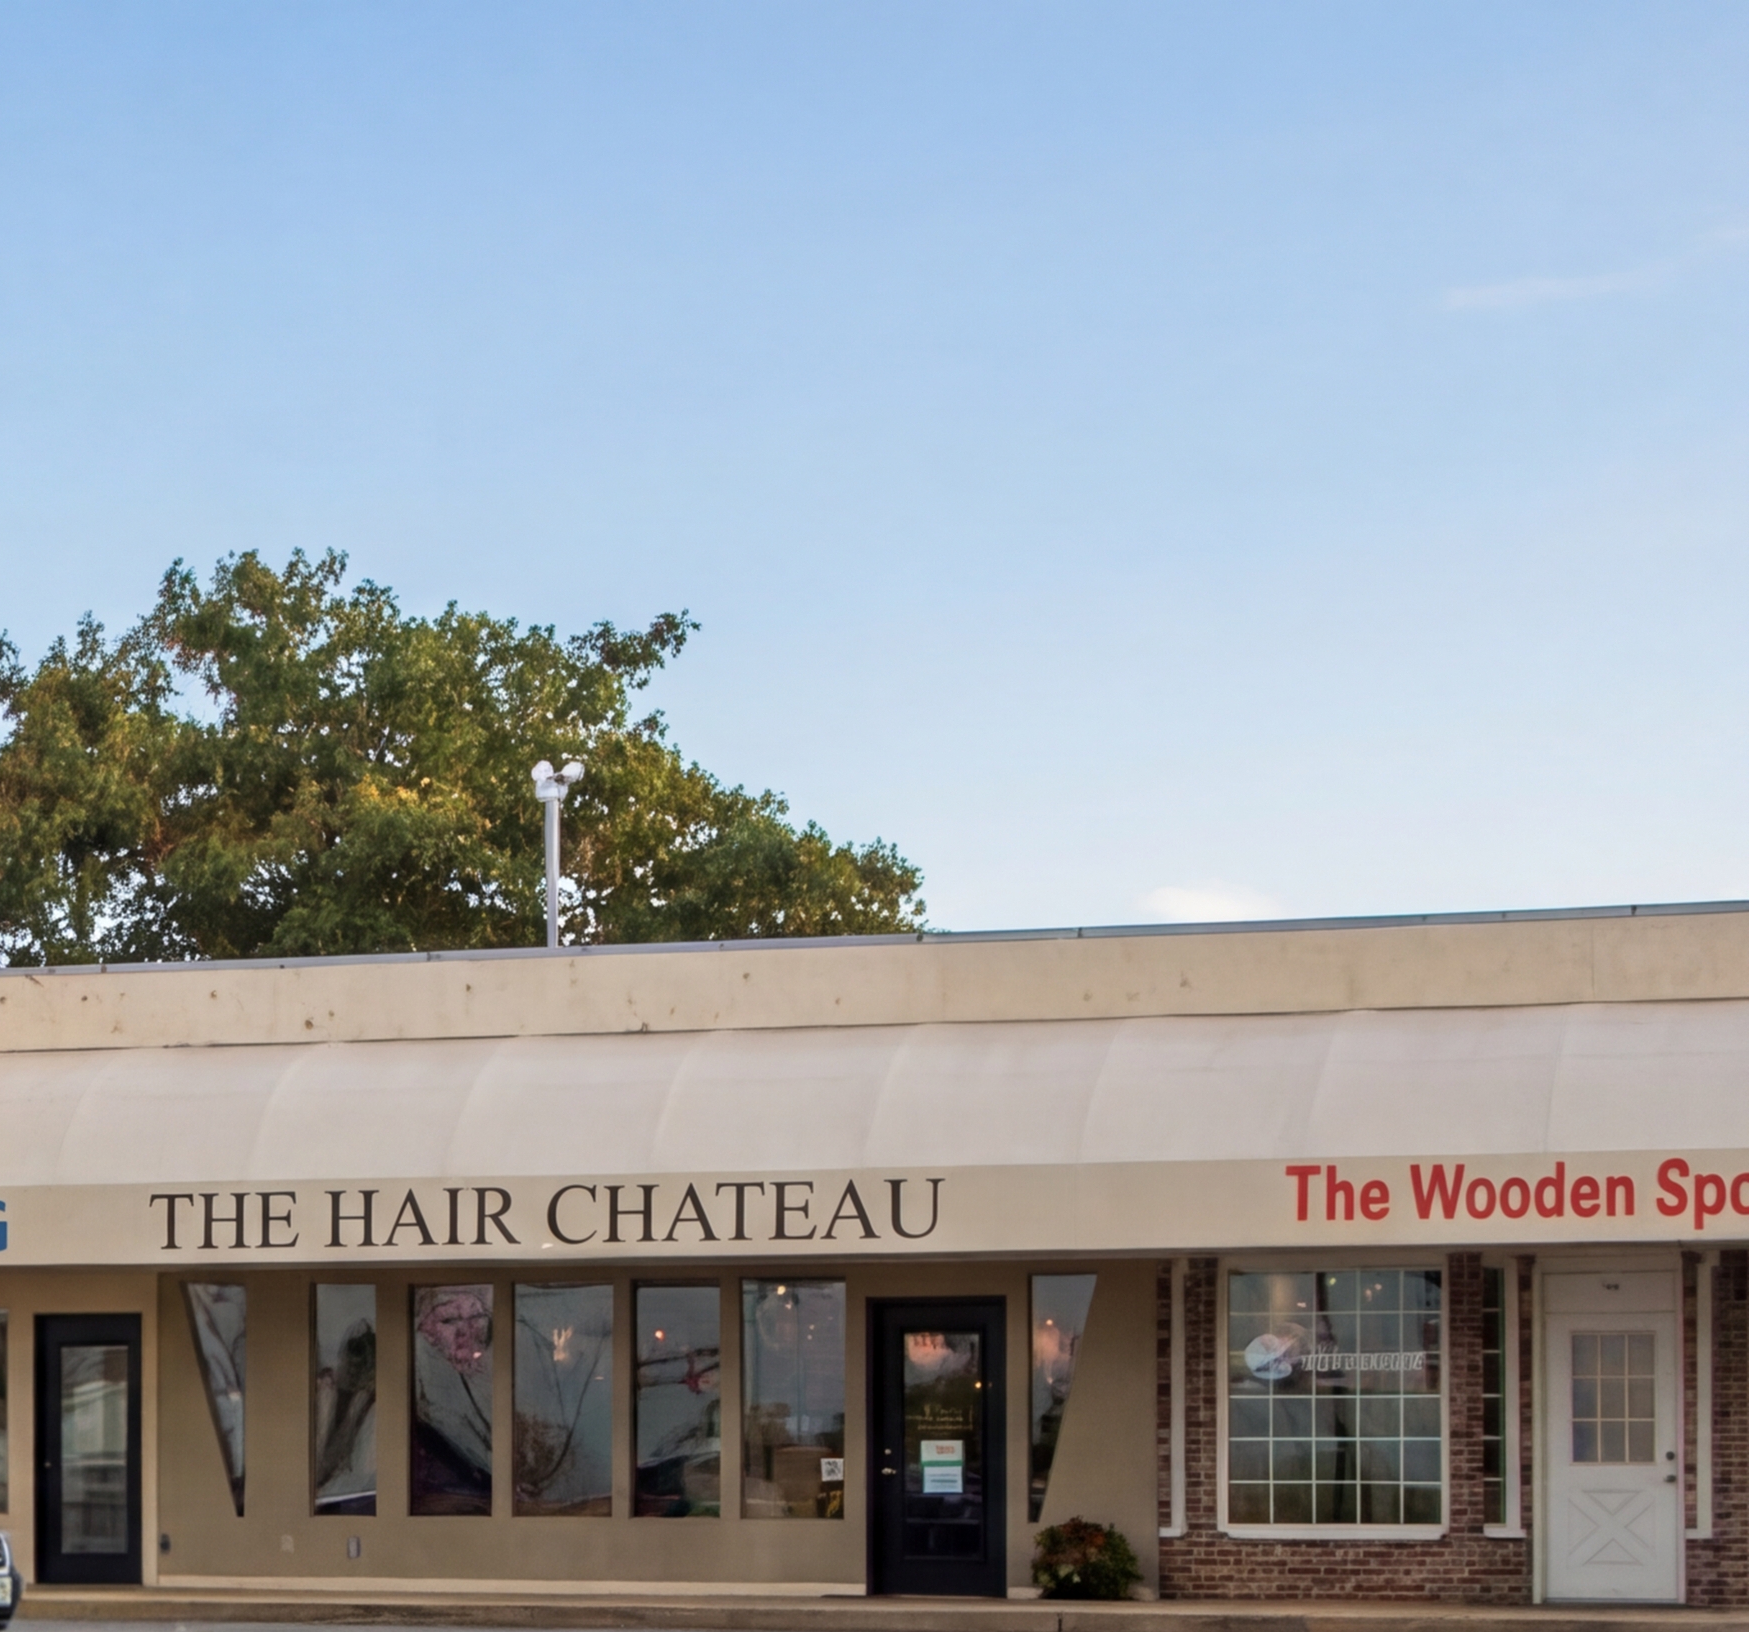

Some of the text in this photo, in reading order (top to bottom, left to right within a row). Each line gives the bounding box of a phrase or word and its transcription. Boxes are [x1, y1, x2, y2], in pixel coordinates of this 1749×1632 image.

[149, 1178, 946, 1250] THE HAIR CHATEAU
[1285, 1165, 1390, 1222] The
[1410, 1161, 1635, 1220] Wooden
